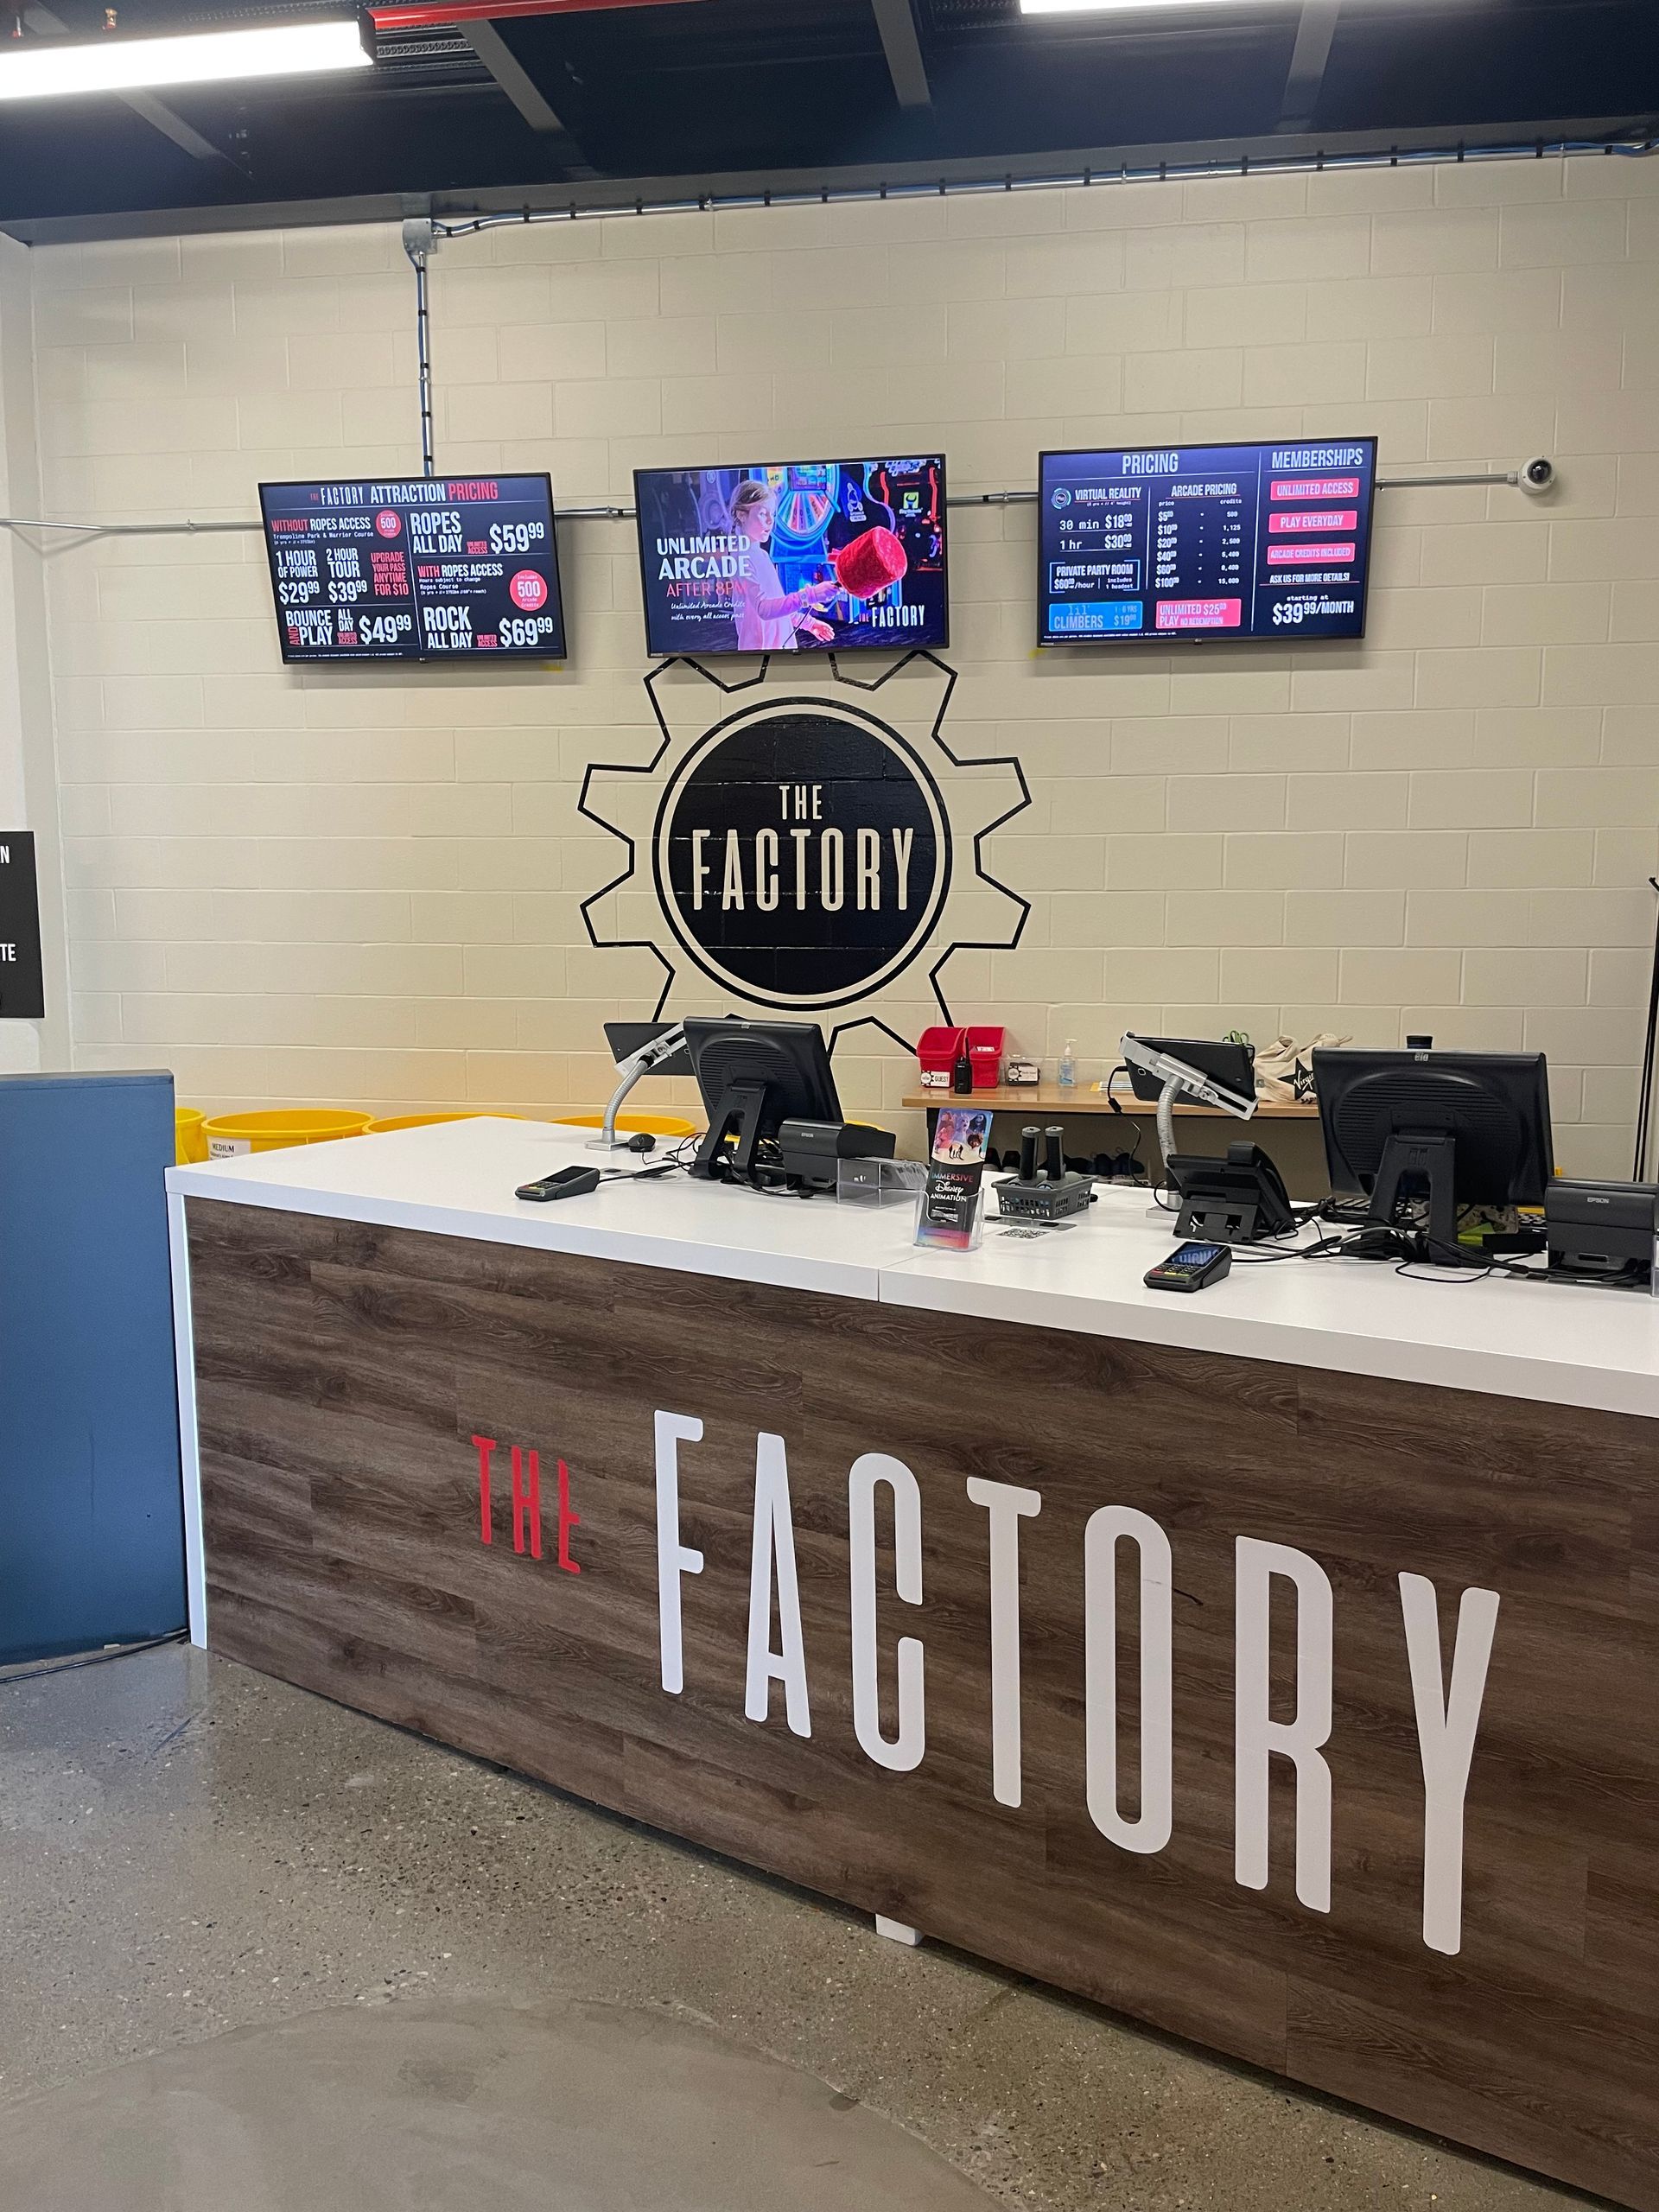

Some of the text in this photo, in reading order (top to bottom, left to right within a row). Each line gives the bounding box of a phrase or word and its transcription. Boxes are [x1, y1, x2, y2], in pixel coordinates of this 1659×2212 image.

[1122, 453, 1179, 474] PRICING
[1272, 448, 1363, 469] MEMBERSHIPS
[321, 486, 363, 505] FACTORY
[371, 484, 446, 504] ATTRACTION
[448, 481, 499, 501] PRICING
[1075, 486, 1141, 500] VIRTUAL REALITY
[1171, 483, 1237, 497] ARCADE PRICING
[1277, 482, 1354, 497] UNLIMITED ACCESS
[271, 517, 371, 532] WITHOUT ROPES ACCESS
[380, 517, 397, 529] 500
[410, 511, 461, 535] ROPES
[1059, 519, 1073, 531] 30
[1078, 519, 1100, 530] min
[1280, 515, 1344, 529] PLAY EVERYDAY
[413, 534, 462, 554] ALL DAY
[656, 535, 751, 556] UNLIMITED
[1059, 541, 1065, 550] 1
[1069, 540, 1083, 550] hr
[276, 550, 317, 567] 1 HOUR
[326, 548, 359, 561] 2 HOUR
[371, 551, 405, 563] UPGRADE
[1270, 547, 1351, 559] ARCADE CREDITS INCLUDED
[277, 566, 318, 578] OF POWER
[327, 561, 360, 578] TOUR
[372, 563, 406, 573] YOUR PASS
[417, 563, 503, 578] WITH ROPES ACCESS
[658, 555, 753, 581] ARCADE
[1056, 563, 1134, 577] PRIVATE PARTY ROOM
[373, 572, 407, 583] ANYTIME
[1269, 572, 1350, 583] ASK US FOR MORE DETAILS!
[374, 583, 410, 596] FOR $10
[517, 580, 541, 597] 500
[666, 581, 748, 598] AFTER 8PM
[337, 608, 353, 620] ALL
[871, 605, 925, 628] FACTORY
[1160, 604, 1202, 615] UNLIMITED
[285, 609, 333, 627] BOUNCE
[423, 606, 473, 632] ROCK
[1054, 614, 1103, 630] CLIMBERS
[1160, 616, 1179, 626] PLAY
[338, 620, 353, 632] DAY
[288, 626, 300, 646] AND
[299, 626, 333, 646] PLAY
[427, 632, 473, 648] ALL DAY
[779, 785, 823, 820] THE
[692, 827, 914, 912] FACTORY
[931, 1173, 974, 1182] IMMERSIVE
[930, 1193, 967, 1202] ANIMATION
[472, 1409, 1501, 1955] THE FACTORY
